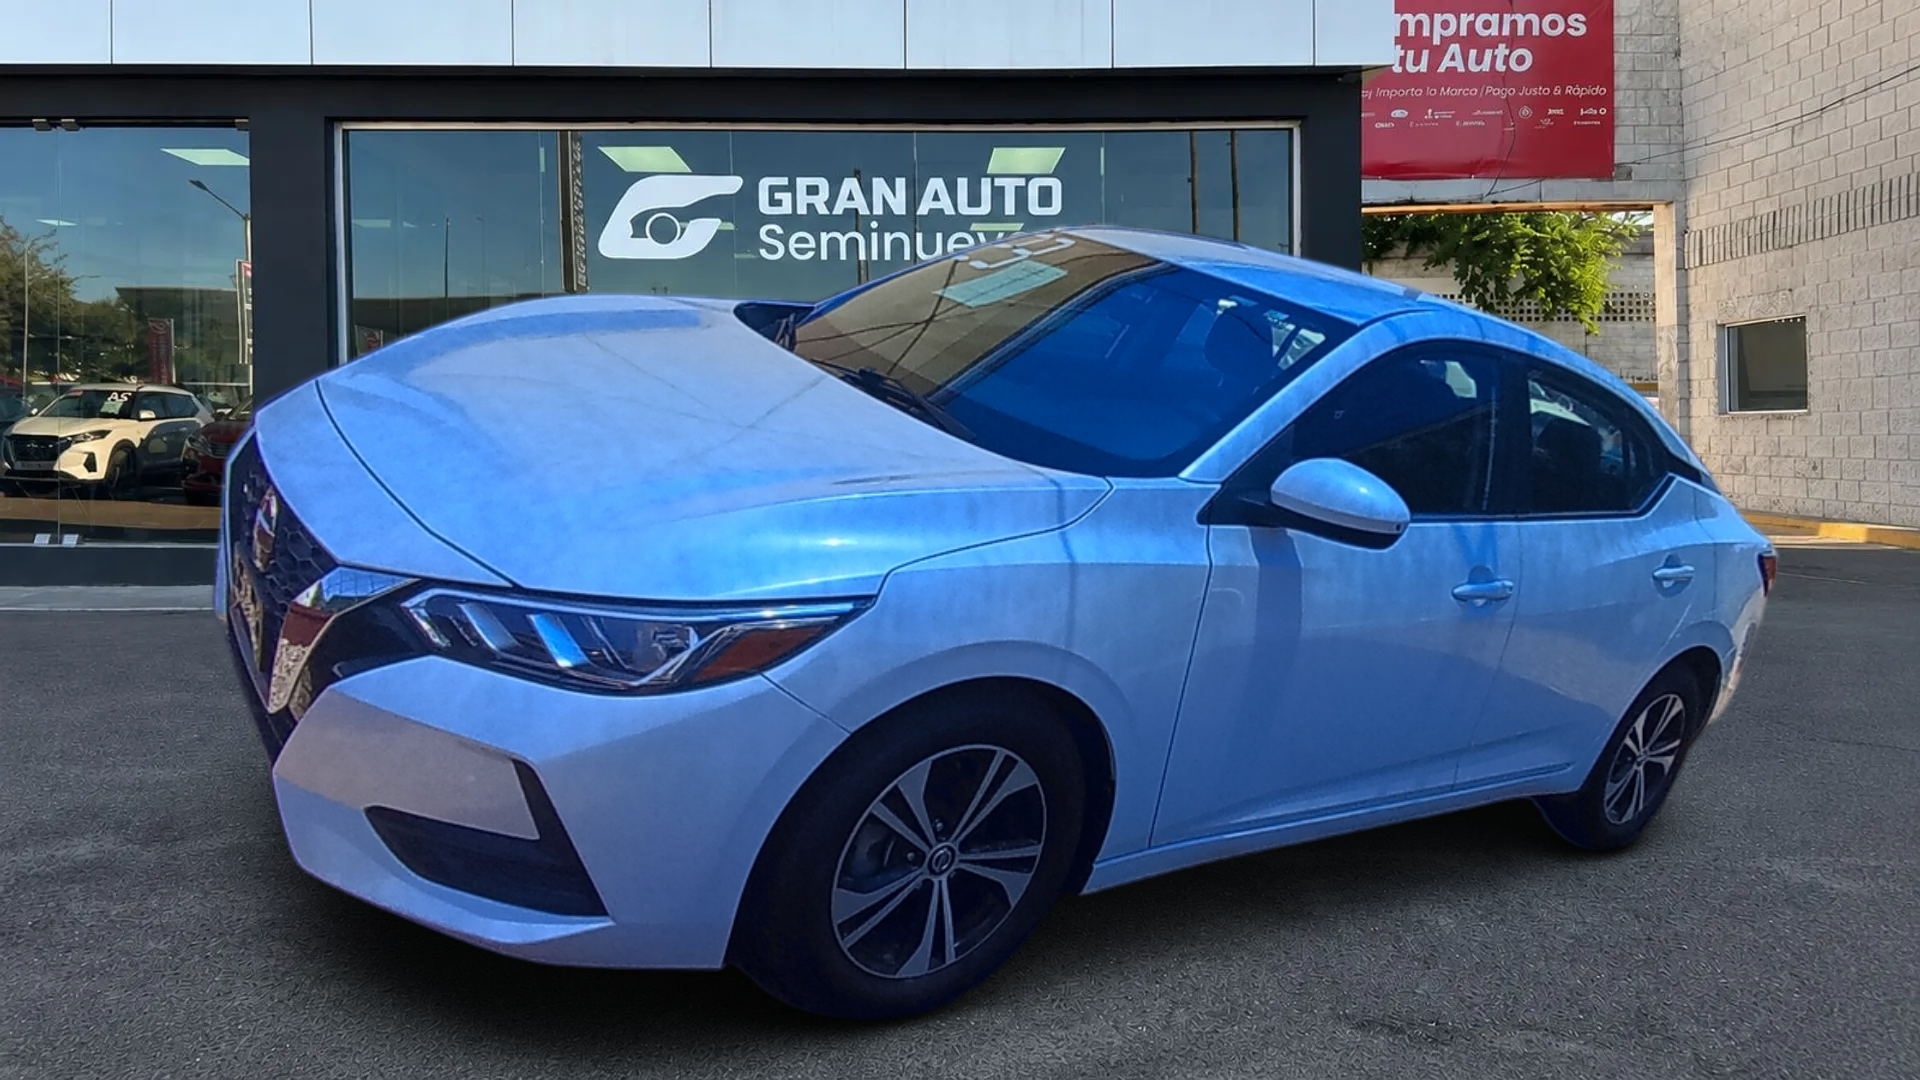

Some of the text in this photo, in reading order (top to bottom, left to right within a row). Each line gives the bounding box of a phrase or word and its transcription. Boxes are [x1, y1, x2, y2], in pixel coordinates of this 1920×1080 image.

[1392, 44, 1533, 73] tu Auto
[1375, 87, 1423, 99] Importa
[1440, 86, 1478, 96] Marca
[1519, 86, 1550, 97] Justo
[1552, 86, 1562, 96] &
[1565, 85, 1607, 98] Rápido
[758, 176, 1063, 215] GRAN AUTO
[759, 221, 1026, 261] Seminuev
